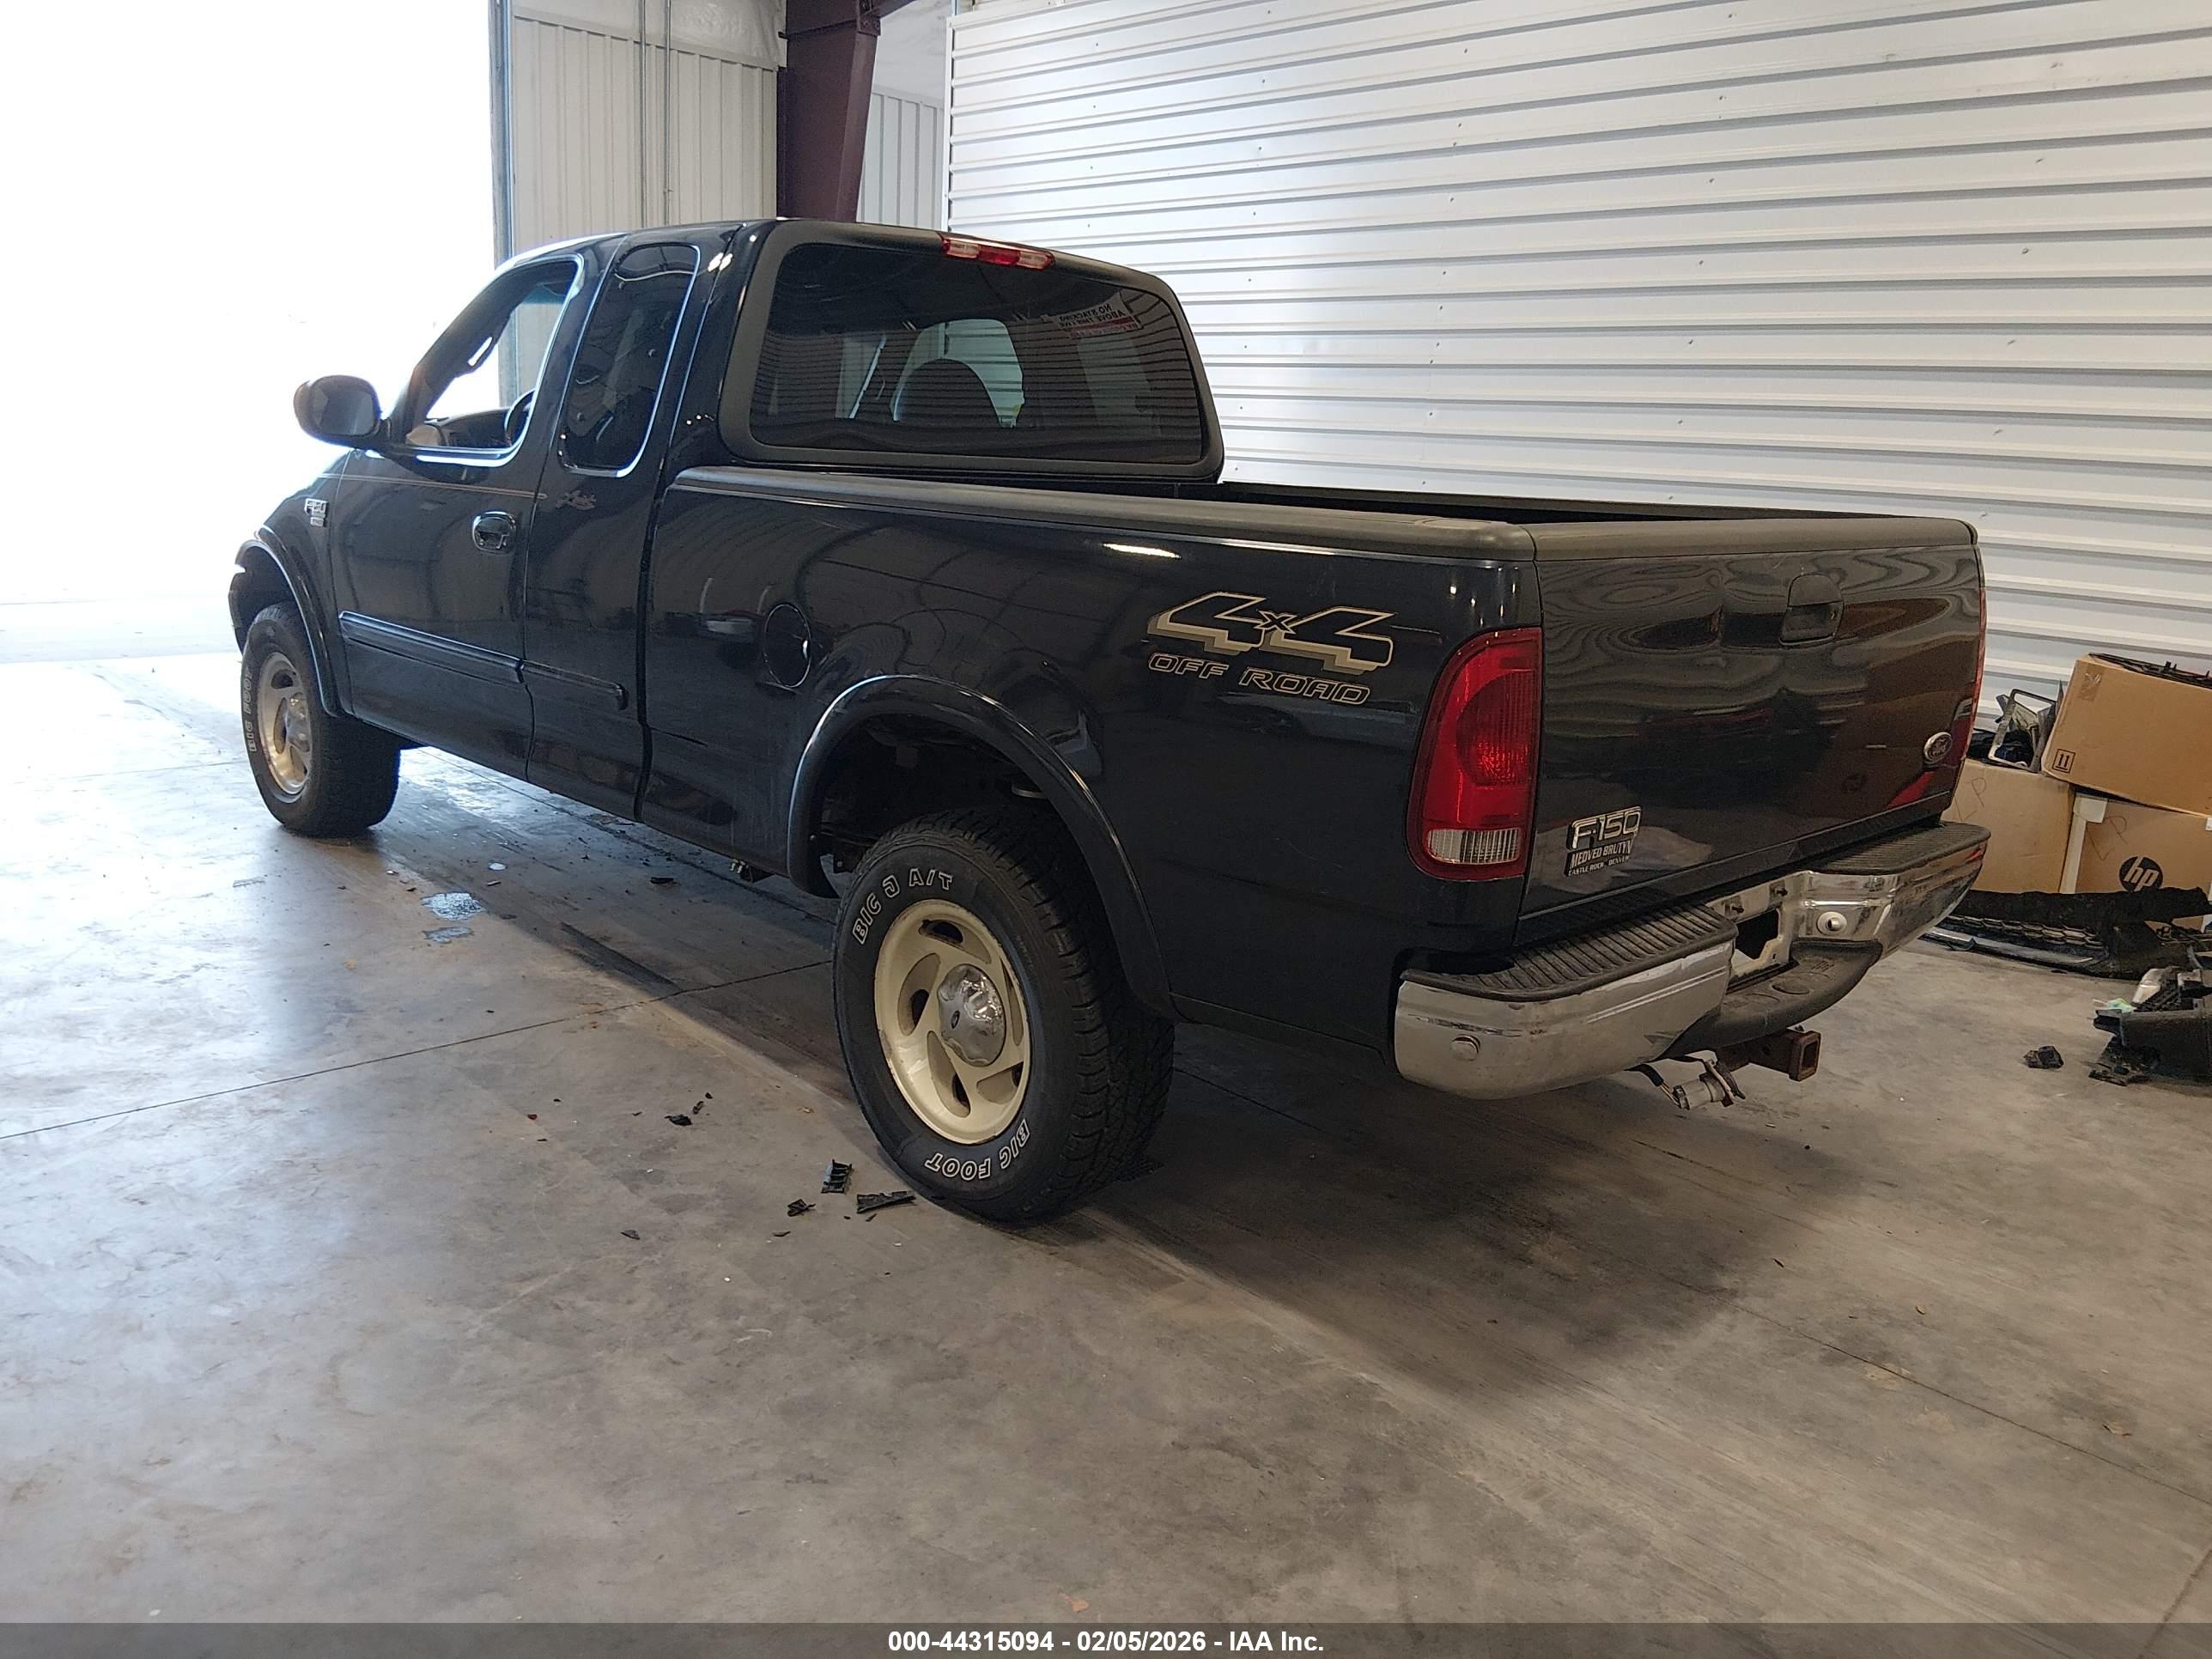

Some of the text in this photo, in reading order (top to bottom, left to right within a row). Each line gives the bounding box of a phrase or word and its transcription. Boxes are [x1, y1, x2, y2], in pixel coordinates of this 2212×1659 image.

[1148, 652, 1371, 705] OFF ROAD
[1570, 839, 1632, 870] MEDVED BRUTYN
[908, 867, 953, 890] A/T
[2123, 856, 2160, 892] hp
[924, 1118, 1030, 1181] BIG FOOT
